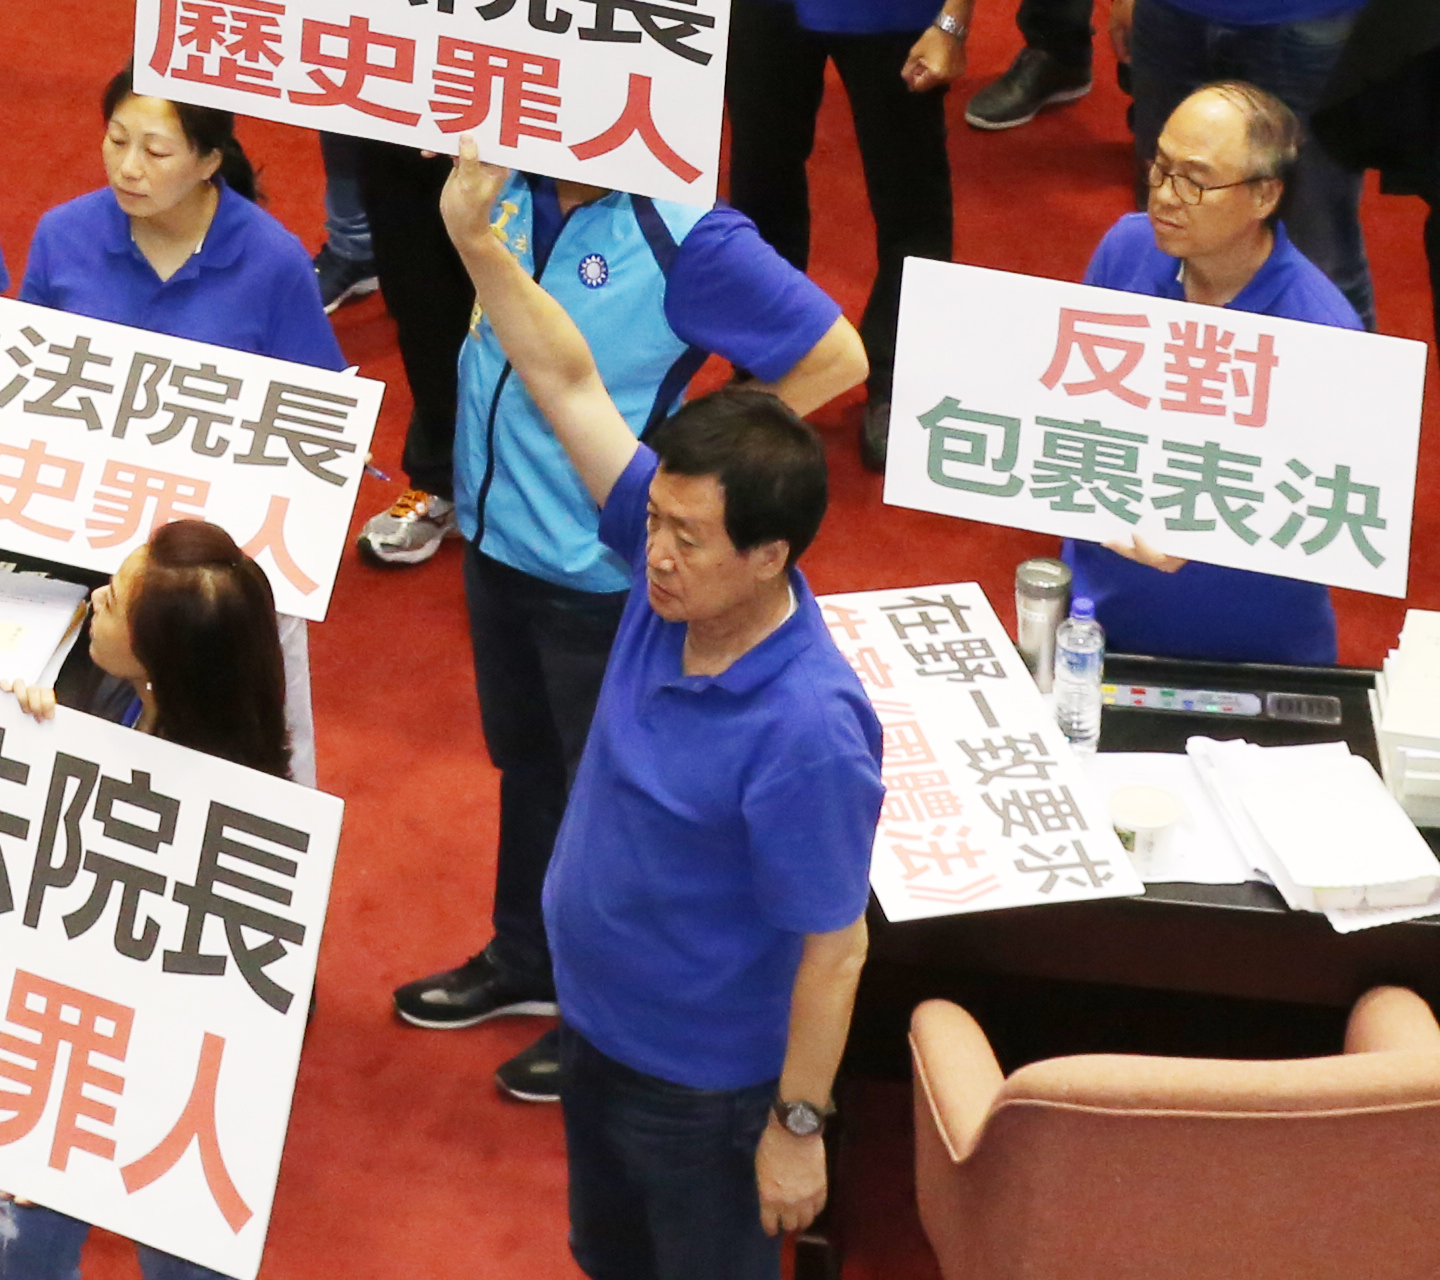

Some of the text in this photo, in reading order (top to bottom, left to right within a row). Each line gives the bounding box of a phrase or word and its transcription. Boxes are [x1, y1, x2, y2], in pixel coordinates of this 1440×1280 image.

[1039, 306, 1279, 429] 反對
[915, 395, 1389, 570] 包裹表決
[878, 594, 1115, 895] 在野一致要求
